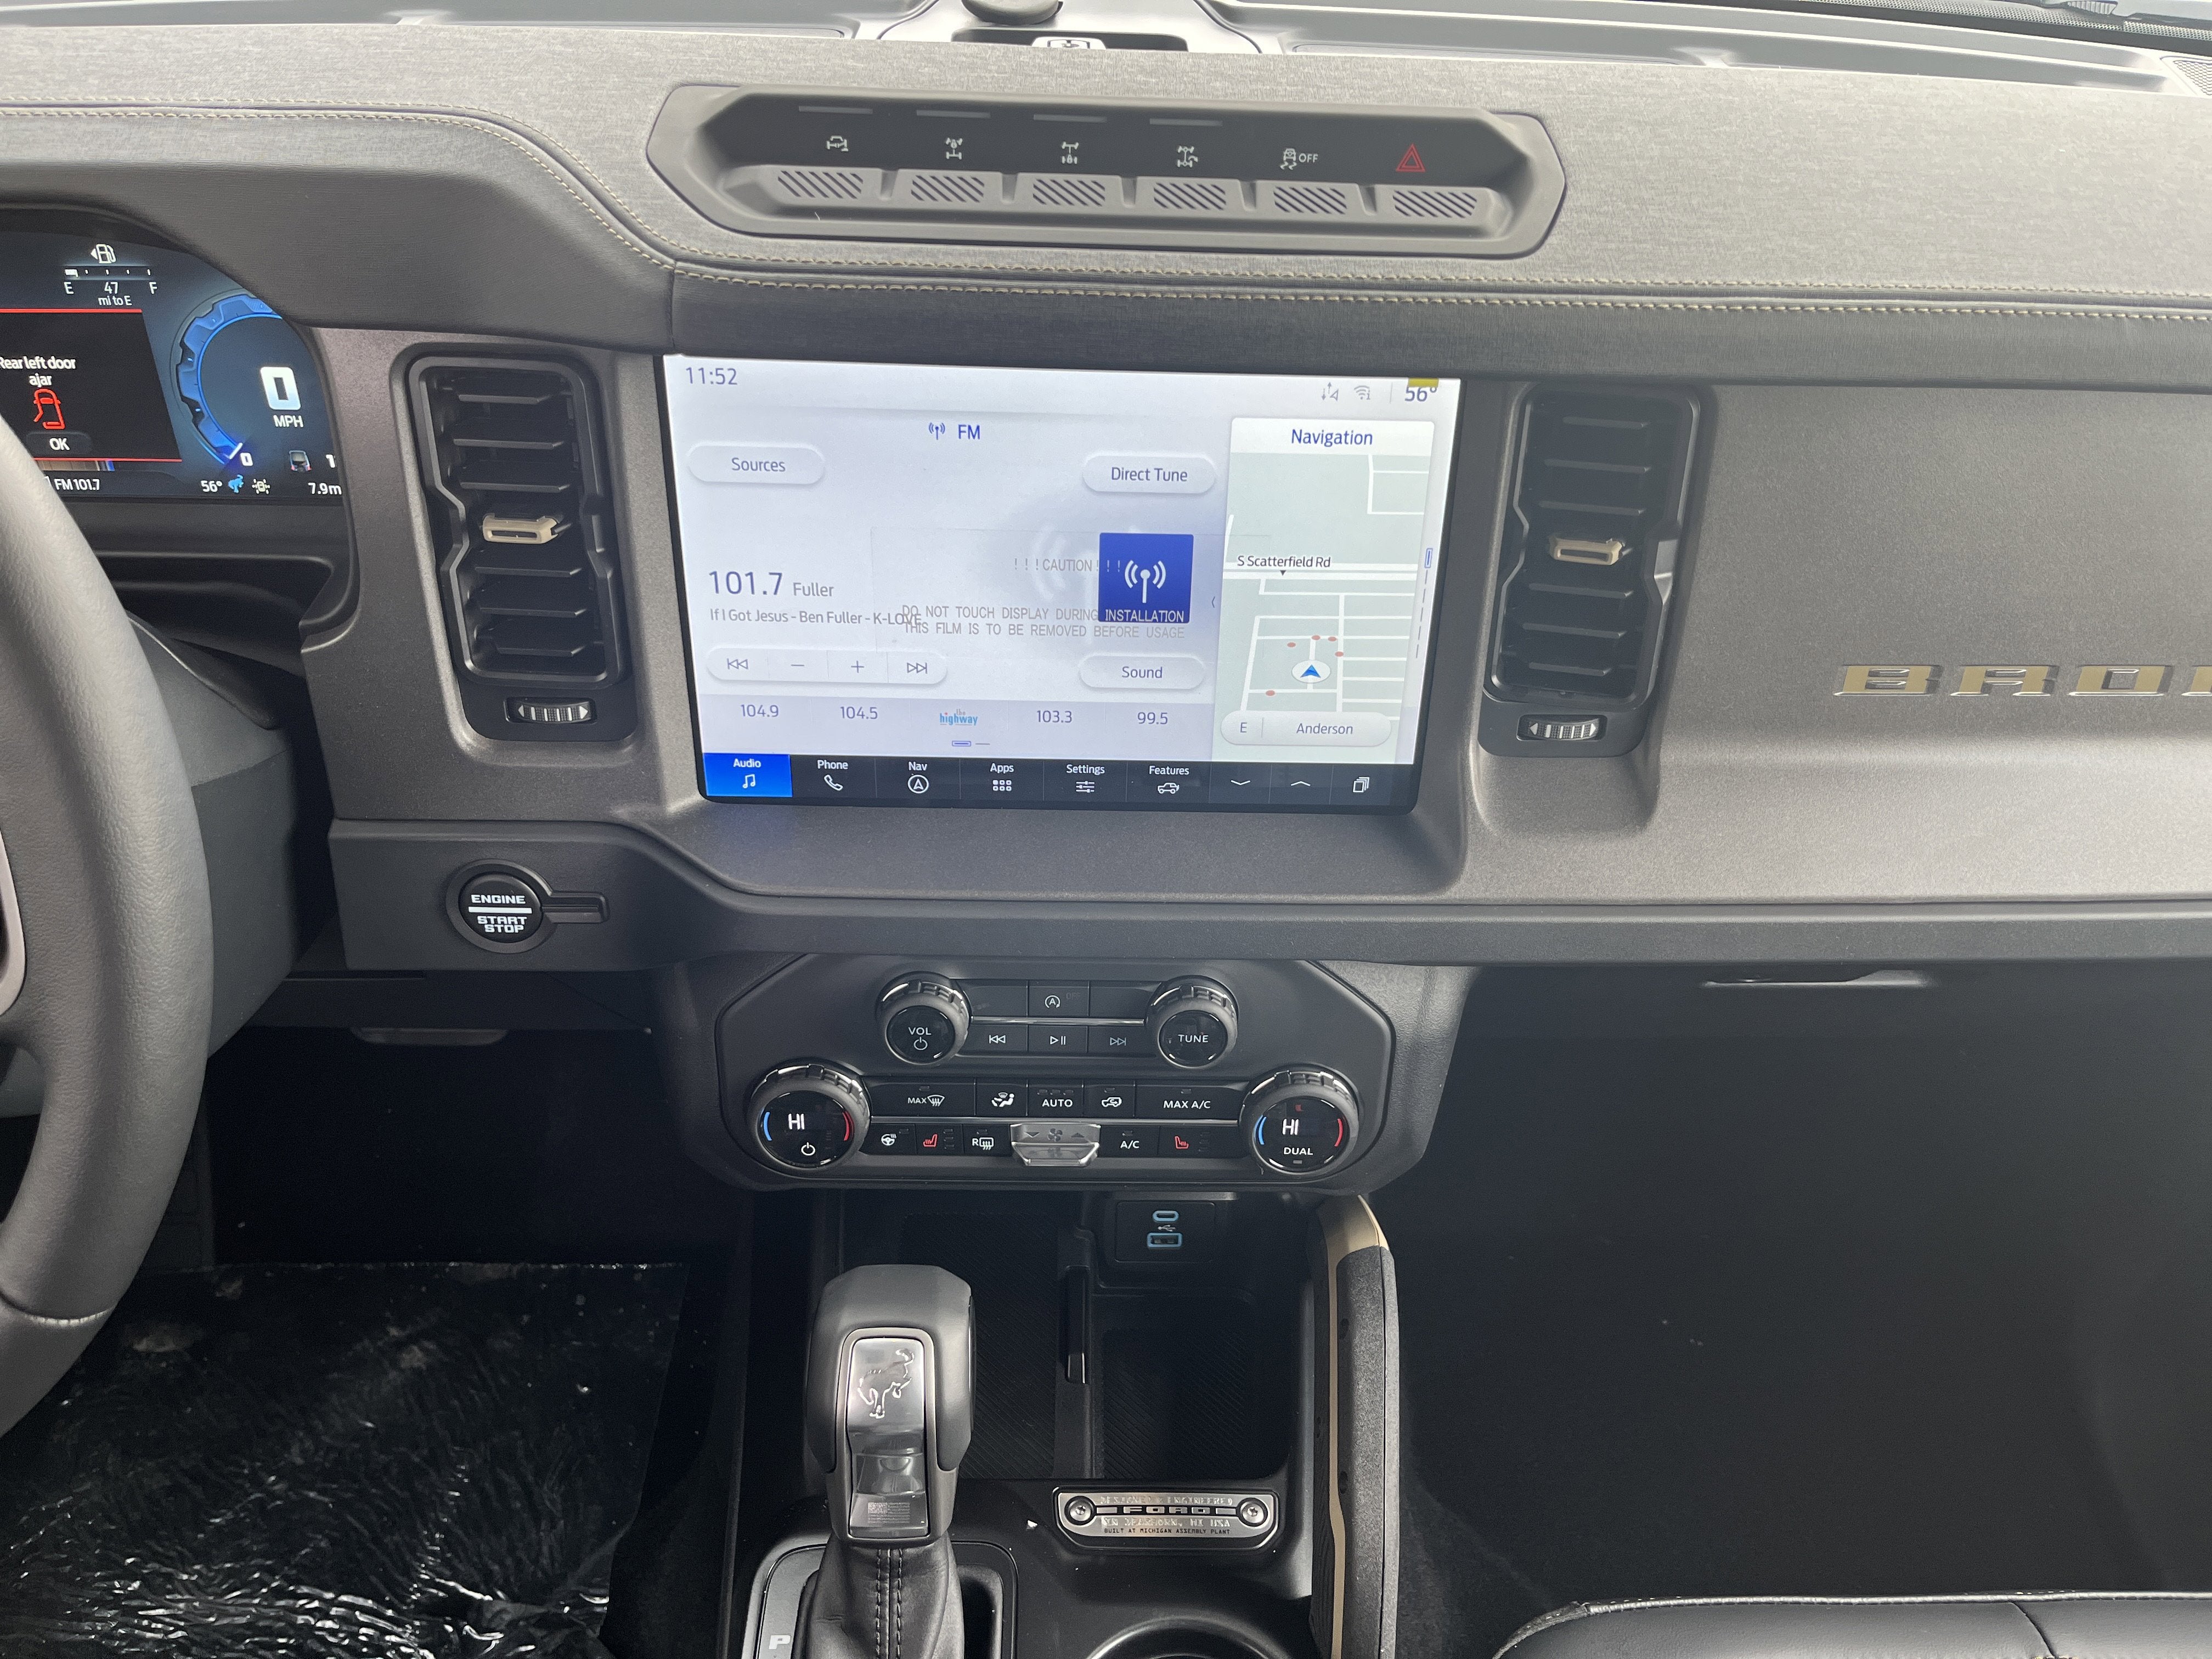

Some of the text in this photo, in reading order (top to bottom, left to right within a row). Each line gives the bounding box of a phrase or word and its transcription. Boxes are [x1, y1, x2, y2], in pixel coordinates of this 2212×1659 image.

[1298, 153, 1318, 163] OFF
[64, 282, 74, 294] E
[104, 282, 119, 294] 47
[149, 282, 158, 295] F
[98, 296, 132, 306] mi to E
[0, 356, 76, 370] Rear left door
[29, 372, 52, 388] ajar
[685, 366, 738, 385] 11:52
[260, 366, 301, 410] 0
[273, 414, 304, 428] MPH
[958, 424, 981, 440] FM
[1291, 428, 1373, 448] Navigation
[49, 438, 70, 451] OK
[240, 452, 253, 466] 0
[731, 456, 787, 473] Sources
[1111, 466, 1188, 482] Direct Tune
[54, 478, 100, 491] FM 101.7
[201, 479, 223, 493] 56°
[1237, 555, 1331, 569] S Scatterfield Rd
[708, 570, 834, 598] 101.7 Fuller
[710, 607, 721, 621] If
[727, 609, 753, 623] Got
[754, 610, 789, 623] Jesus
[799, 611, 824, 624] Ben
[826, 611, 863, 625] Fuller
[873, 612, 922, 626] K-LOVE
[926, 605, 950, 618] NOT
[955, 606, 995, 619] TOUCH
[1002, 607, 1049, 620] DISPLAY
[1055, 608, 1099, 622] DURING
[1104, 610, 1185, 623] INSTALLATION
[903, 621, 1185, 639] THIS FILM IS TO BE REMOVED BEFORE USAGE
[1121, 665, 1164, 680] Sound
[1834, 664, 2212, 697] BRO
[740, 704, 780, 718] 104.9
[839, 706, 879, 720] 104.5
[1036, 709, 1073, 724] 103.3
[1137, 710, 1169, 726] 99.5
[939, 712, 978, 726] highway
[1239, 721, 1248, 733] E
[1296, 722, 1354, 736] Anderson
[733, 757, 762, 769] Audio
[816, 759, 849, 770] Phone
[908, 761, 928, 772] Nav
[989, 763, 1014, 775] Apps
[1065, 763, 1105, 776] Settings
[1148, 764, 1190, 776] Features
[470, 894, 526, 905] ENGINE
[477, 915, 528, 926] START
[484, 924, 524, 934] STOP
[908, 1026, 932, 1036] VOL
[1178, 1034, 1209, 1043] TUNE
[907, 1097, 928, 1105] MAX
[1041, 1098, 1073, 1108] AUTO
[1163, 1099, 1211, 1110] MAX A/C
[787, 1113, 805, 1130] HI
[1282, 1119, 1299, 1136] HI
[1120, 1139, 1141, 1150] A/C
[1283, 1147, 1314, 1156] DUAL
[1123, 1505, 1211, 1514] FORD
[1210, 1518, 1231, 1527] USA
[768, 1634, 791, 1650] P
